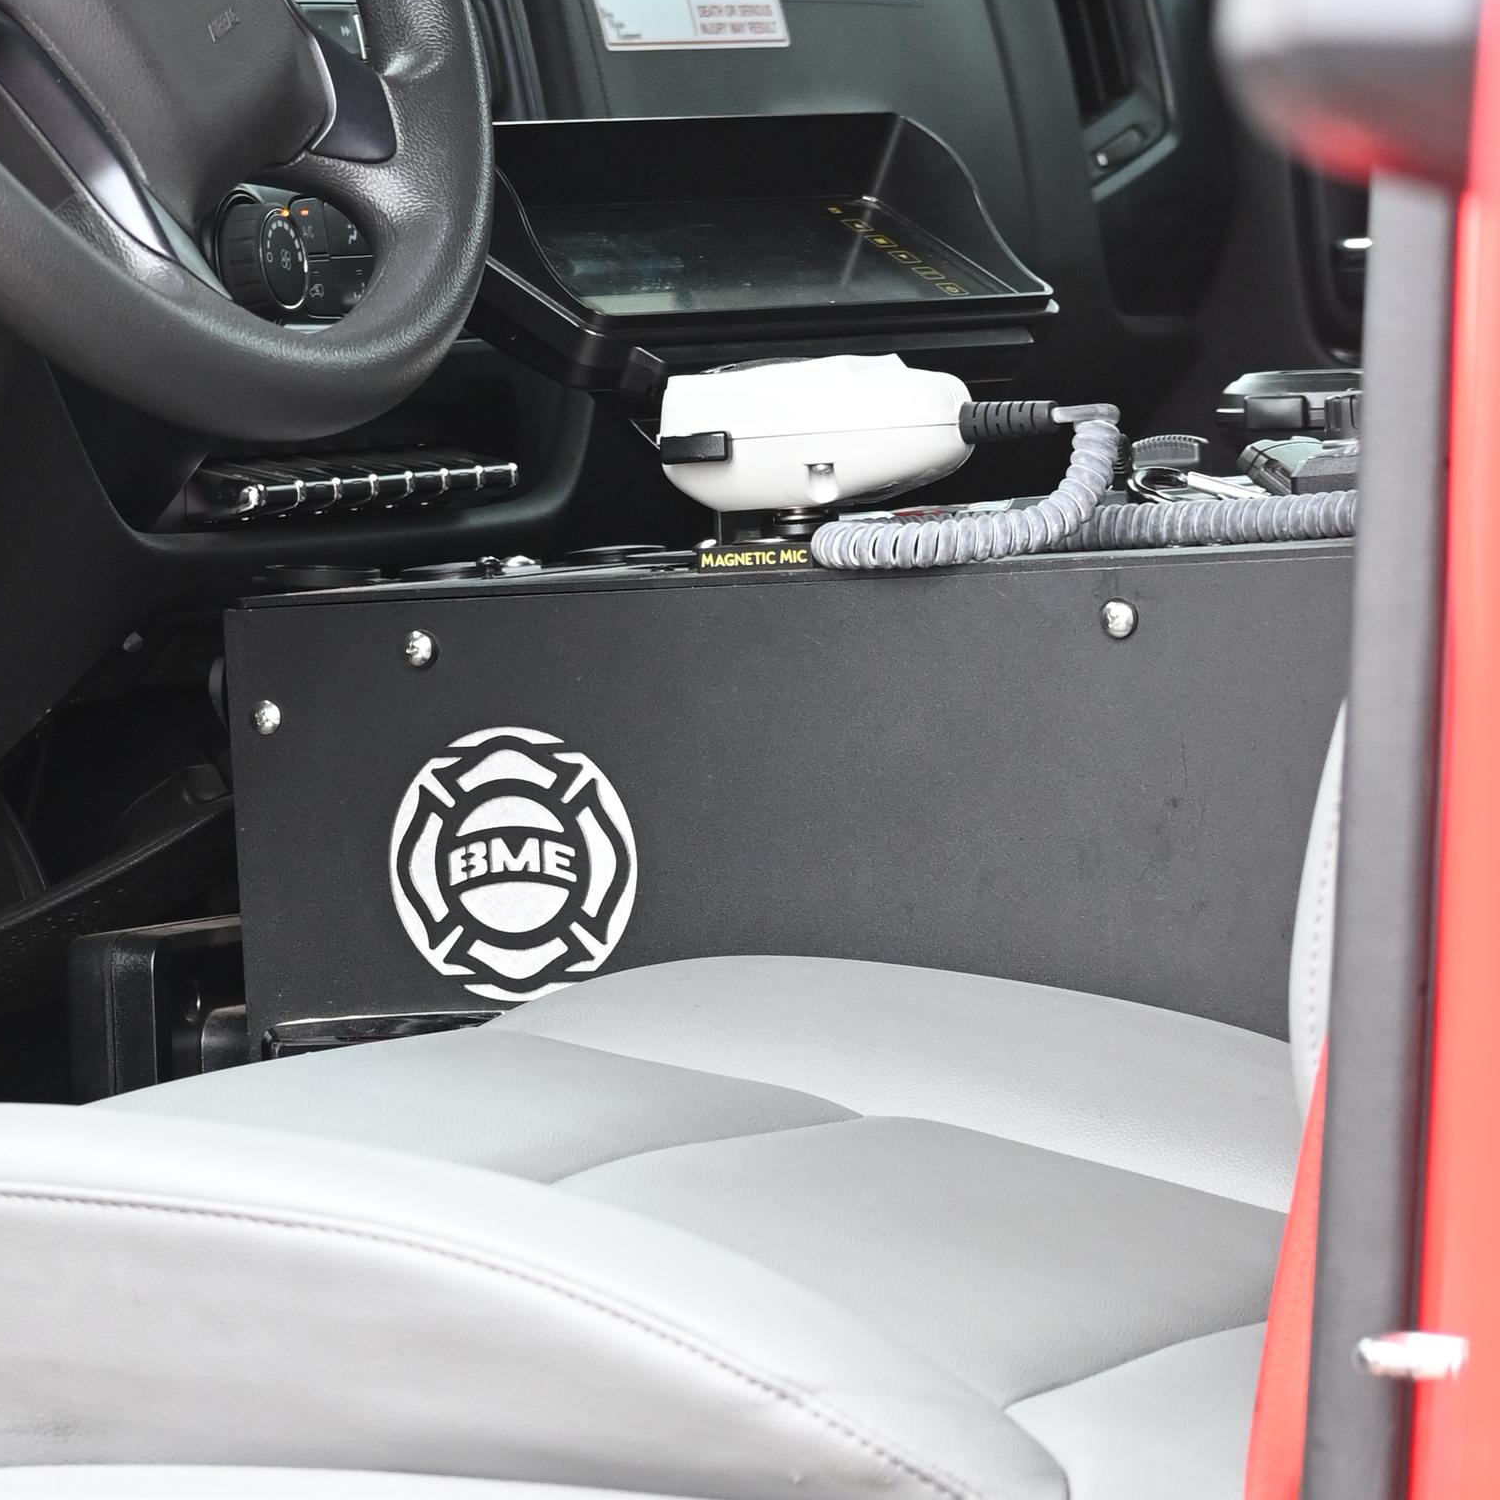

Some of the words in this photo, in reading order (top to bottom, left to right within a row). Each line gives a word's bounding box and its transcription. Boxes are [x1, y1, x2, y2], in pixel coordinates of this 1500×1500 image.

[700, 550, 776, 568] MAGNETIC
[779, 548, 808, 564] MIC
[448, 835, 578, 887] BME
